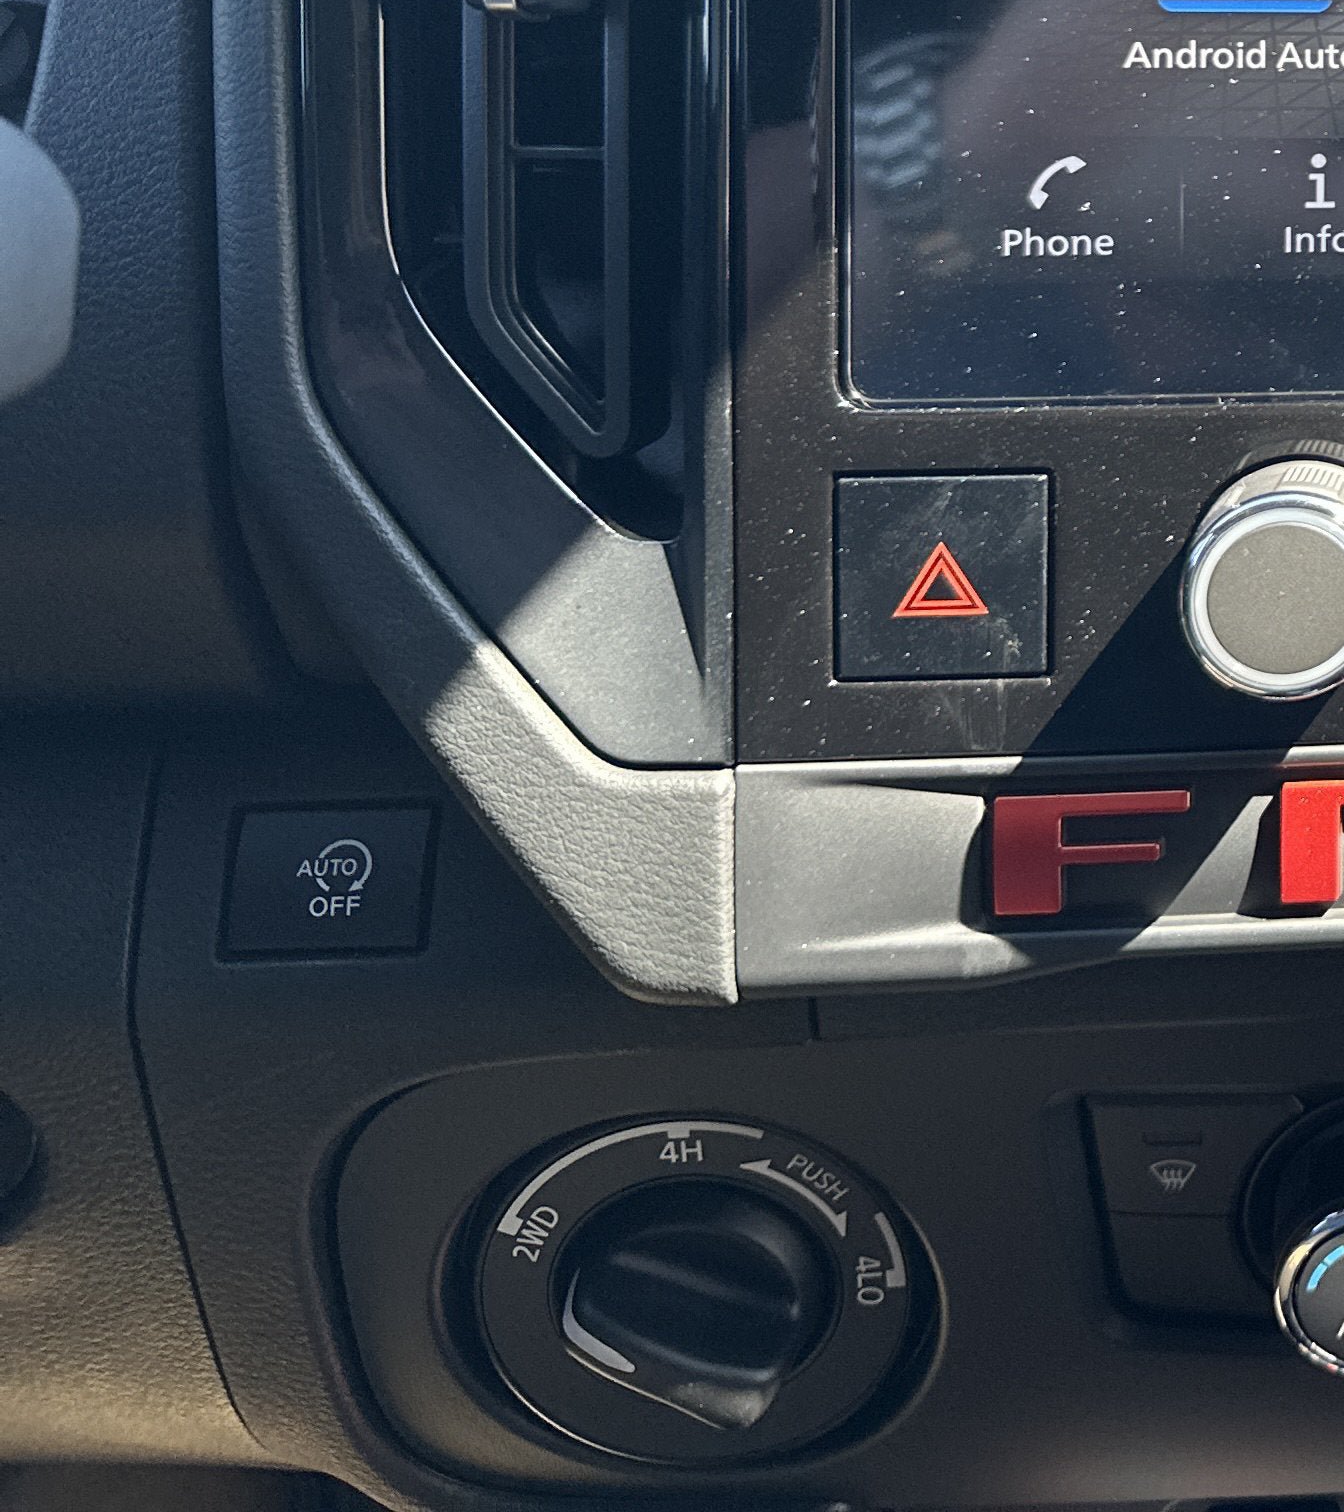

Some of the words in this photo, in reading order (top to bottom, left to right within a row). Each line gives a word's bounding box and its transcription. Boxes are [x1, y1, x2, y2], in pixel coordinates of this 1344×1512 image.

[1123, 39, 1267, 70] Android
[1001, 227, 1115, 257] Phone
[296, 858, 358, 877] AUTO
[308, 895, 361, 918] OFF
[659, 1139, 705, 1164] 4H
[786, 1153, 850, 1202] PUSH
[511, 1204, 560, 1263] 2WD
[856, 1254, 885, 1306] 4LO
